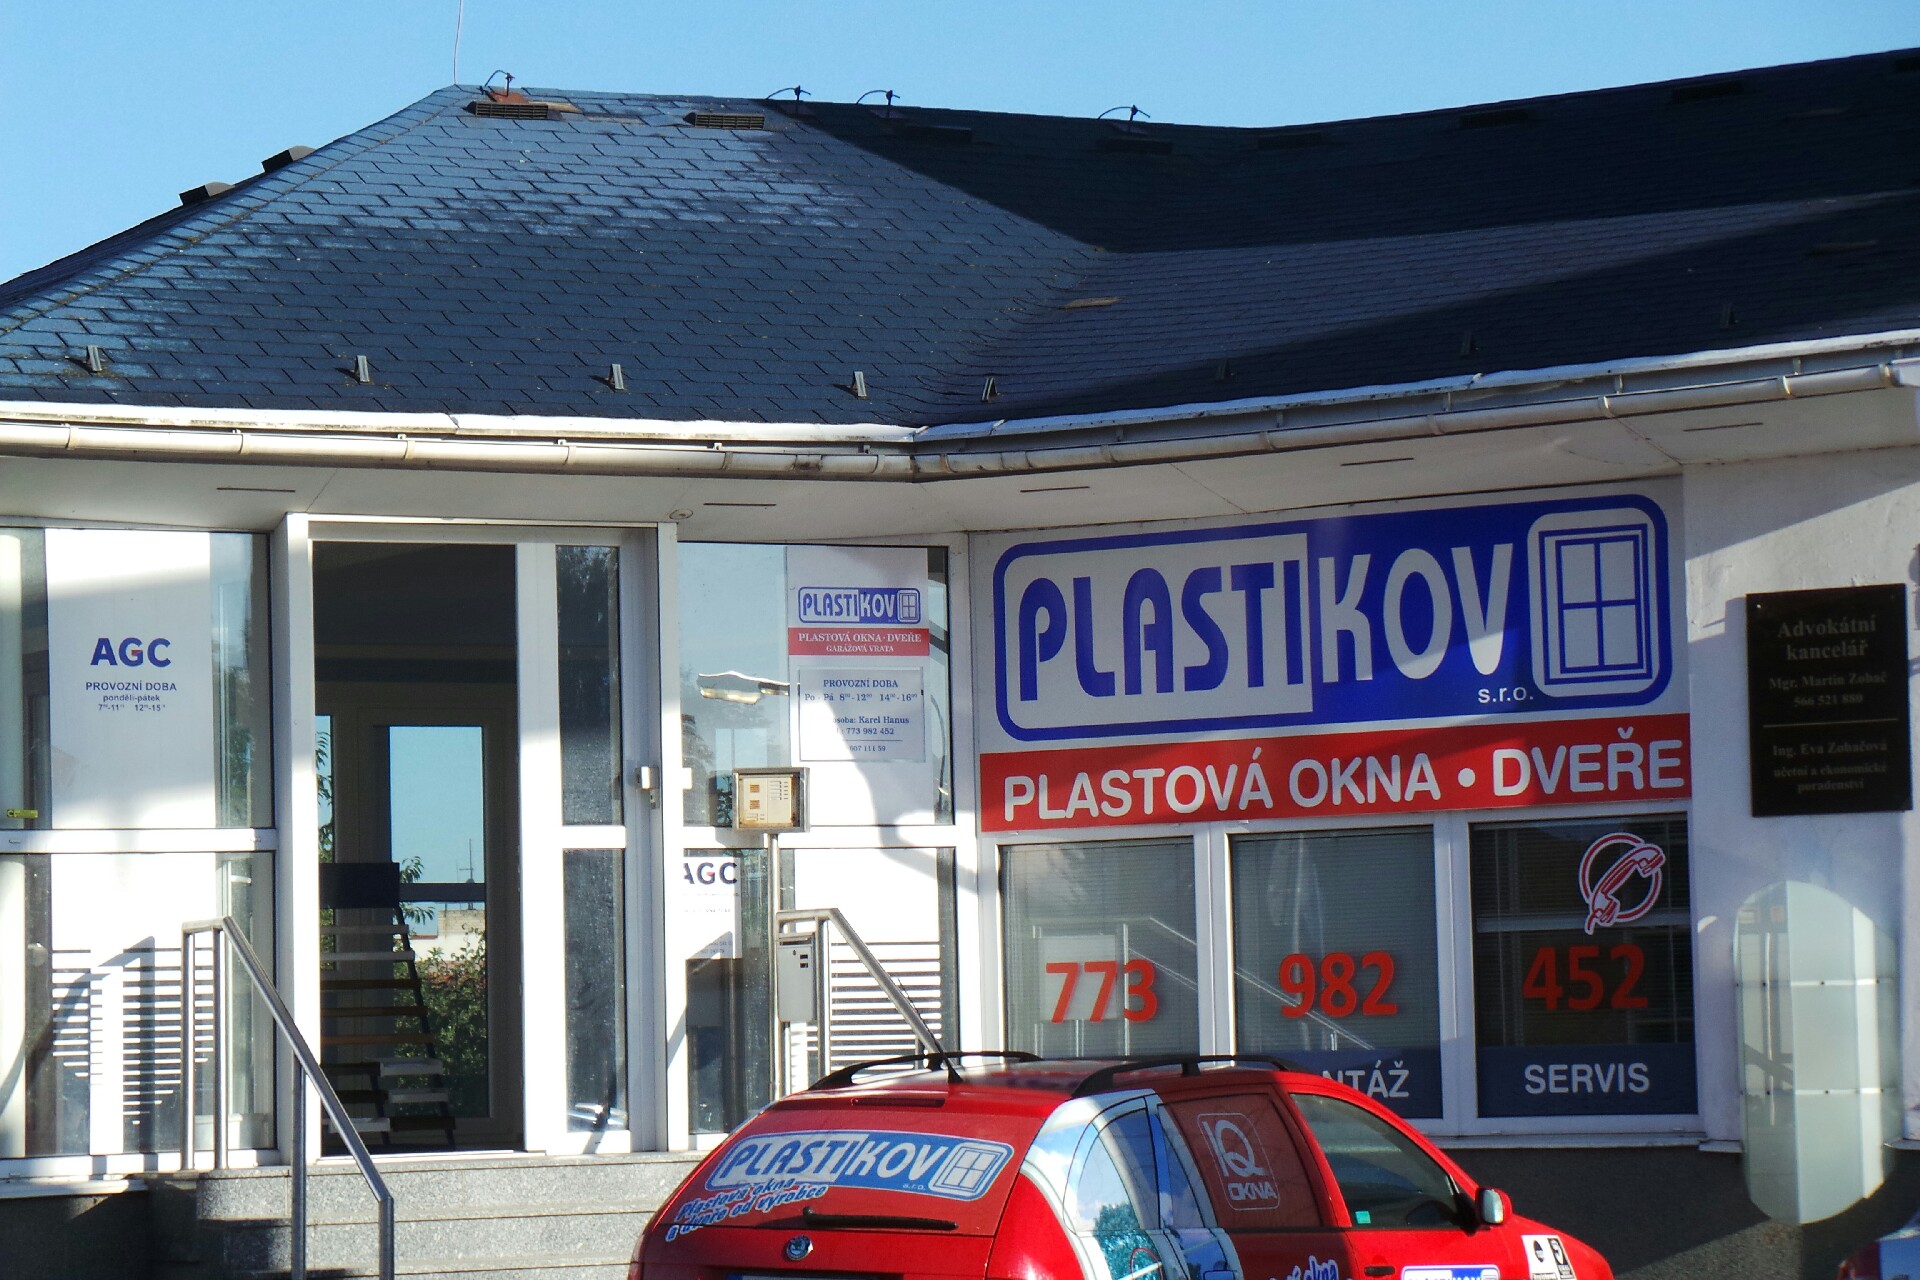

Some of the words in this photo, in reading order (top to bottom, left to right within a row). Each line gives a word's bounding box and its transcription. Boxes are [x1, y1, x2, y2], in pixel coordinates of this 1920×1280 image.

[803, 592, 895, 618] PLASTIKOV
[1018, 543, 1513, 702] PLASTIKOV
[1777, 614, 1876, 638] Advokátní
[798, 632, 850, 642] PLASTOVÁ
[853, 633, 882, 642] OKNA
[887, 632, 922, 642] DVEŘE
[90, 637, 171, 668] AGC
[826, 644, 868, 653] GARÁŽOVÁ
[870, 645, 894, 653] VRATA
[1786, 640, 1869, 661] kancelář
[85, 680, 143, 691] PROVOZNÍ
[146, 683, 177, 691] DOBA
[823, 678, 870, 688] PROVOZNÍ
[872, 680, 899, 688] DOBA
[1769, 677, 1798, 690] Mgr.
[1802, 674, 1844, 687] Martin
[823, 693, 834, 701] Pá
[1478, 687, 1534, 703] s.r.o.
[858, 716, 881, 724] Karel
[883, 716, 910, 724] Hanus
[846, 727, 860, 735] 773
[863, 727, 878, 735] 982
[879, 727, 895, 735] 452
[1773, 744, 1797, 759] Ing.
[1801, 743, 1823, 756] Eva
[1003, 746, 1274, 822] PLASTOVÁ
[1289, 753, 1442, 809] OKNA
[1492, 725, 1684, 797] DVEŘE
[1045, 959, 1158, 1023] 773
[1278, 951, 1399, 1019] 982
[1522, 943, 1649, 1011] 452
[1524, 1061, 1651, 1095] SERVIS
[720, 1140, 952, 1181] PLASTIKOV
[1227, 1181, 1277, 1201] OKNA
